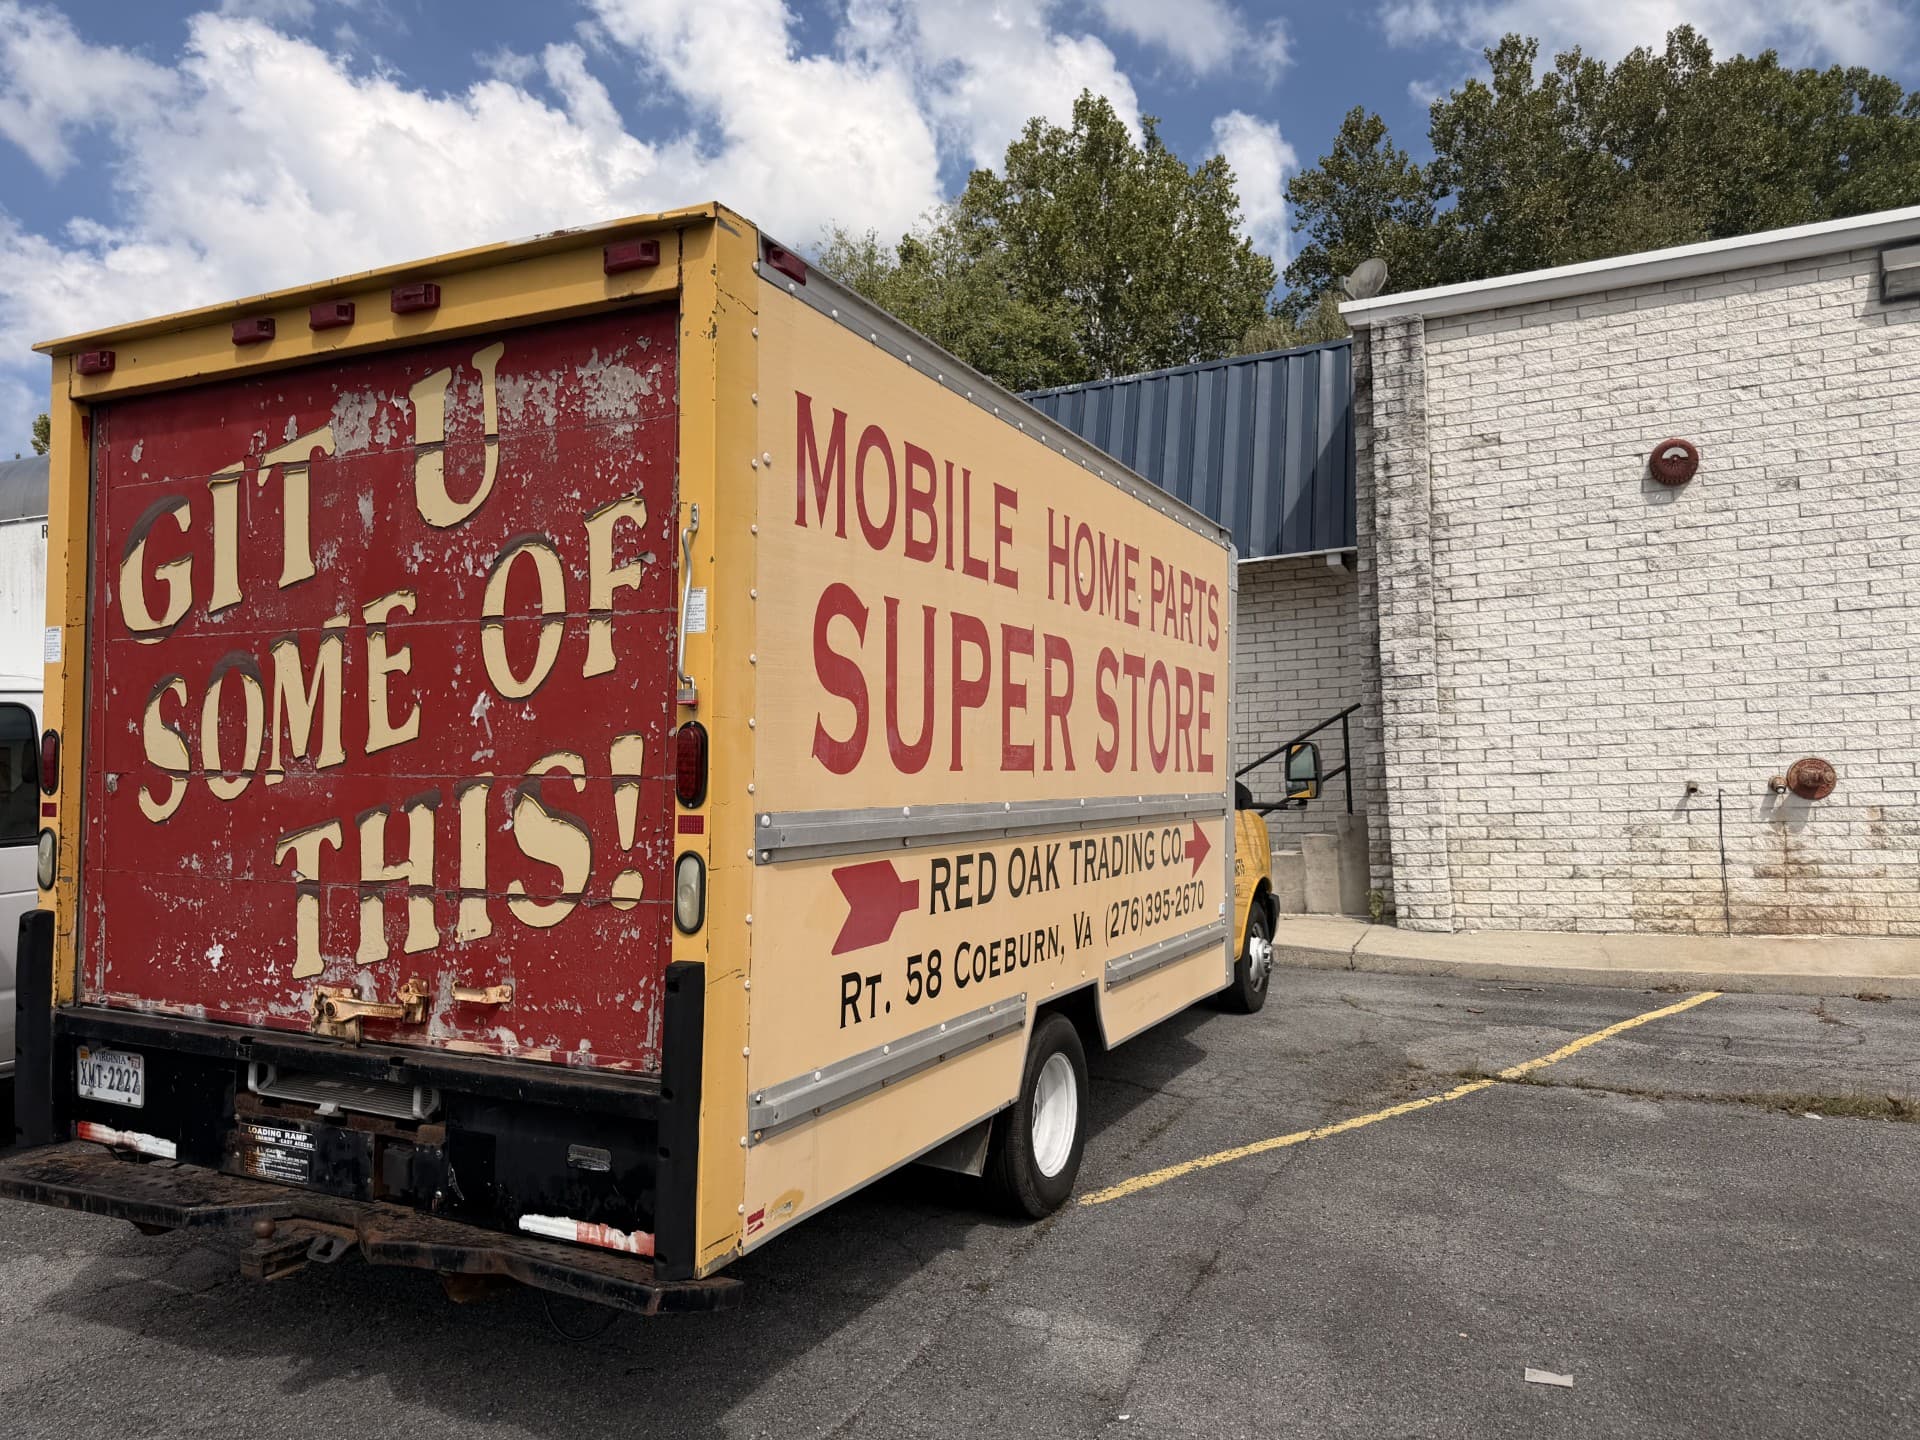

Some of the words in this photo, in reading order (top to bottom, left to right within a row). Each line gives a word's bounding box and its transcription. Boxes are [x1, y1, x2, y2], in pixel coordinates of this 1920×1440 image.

[119, 426, 336, 644] GIT
[408, 341, 505, 528] U
[795, 390, 1019, 594] MOBILE
[1048, 507, 1139, 631] HOME
[1151, 555, 1219, 652] PARTS
[138, 589, 421, 823] SOME
[480, 495, 648, 700] OF
[812, 582, 1076, 777] SUPER
[1095, 646, 1215, 775] STORE
[274, 733, 645, 979] THIS!
[905, 949, 943, 1005] 58
[1105, 880, 1205, 947] (276)395-2670
[929, 851, 997, 916] RED
[1007, 843, 1061, 898] OAK
[1069, 830, 1155, 885] TRADING
[1161, 827, 1184, 866] CO.
[248, 1126, 281, 1138] LOADING
[285, 1132, 308, 1142] RAMP
